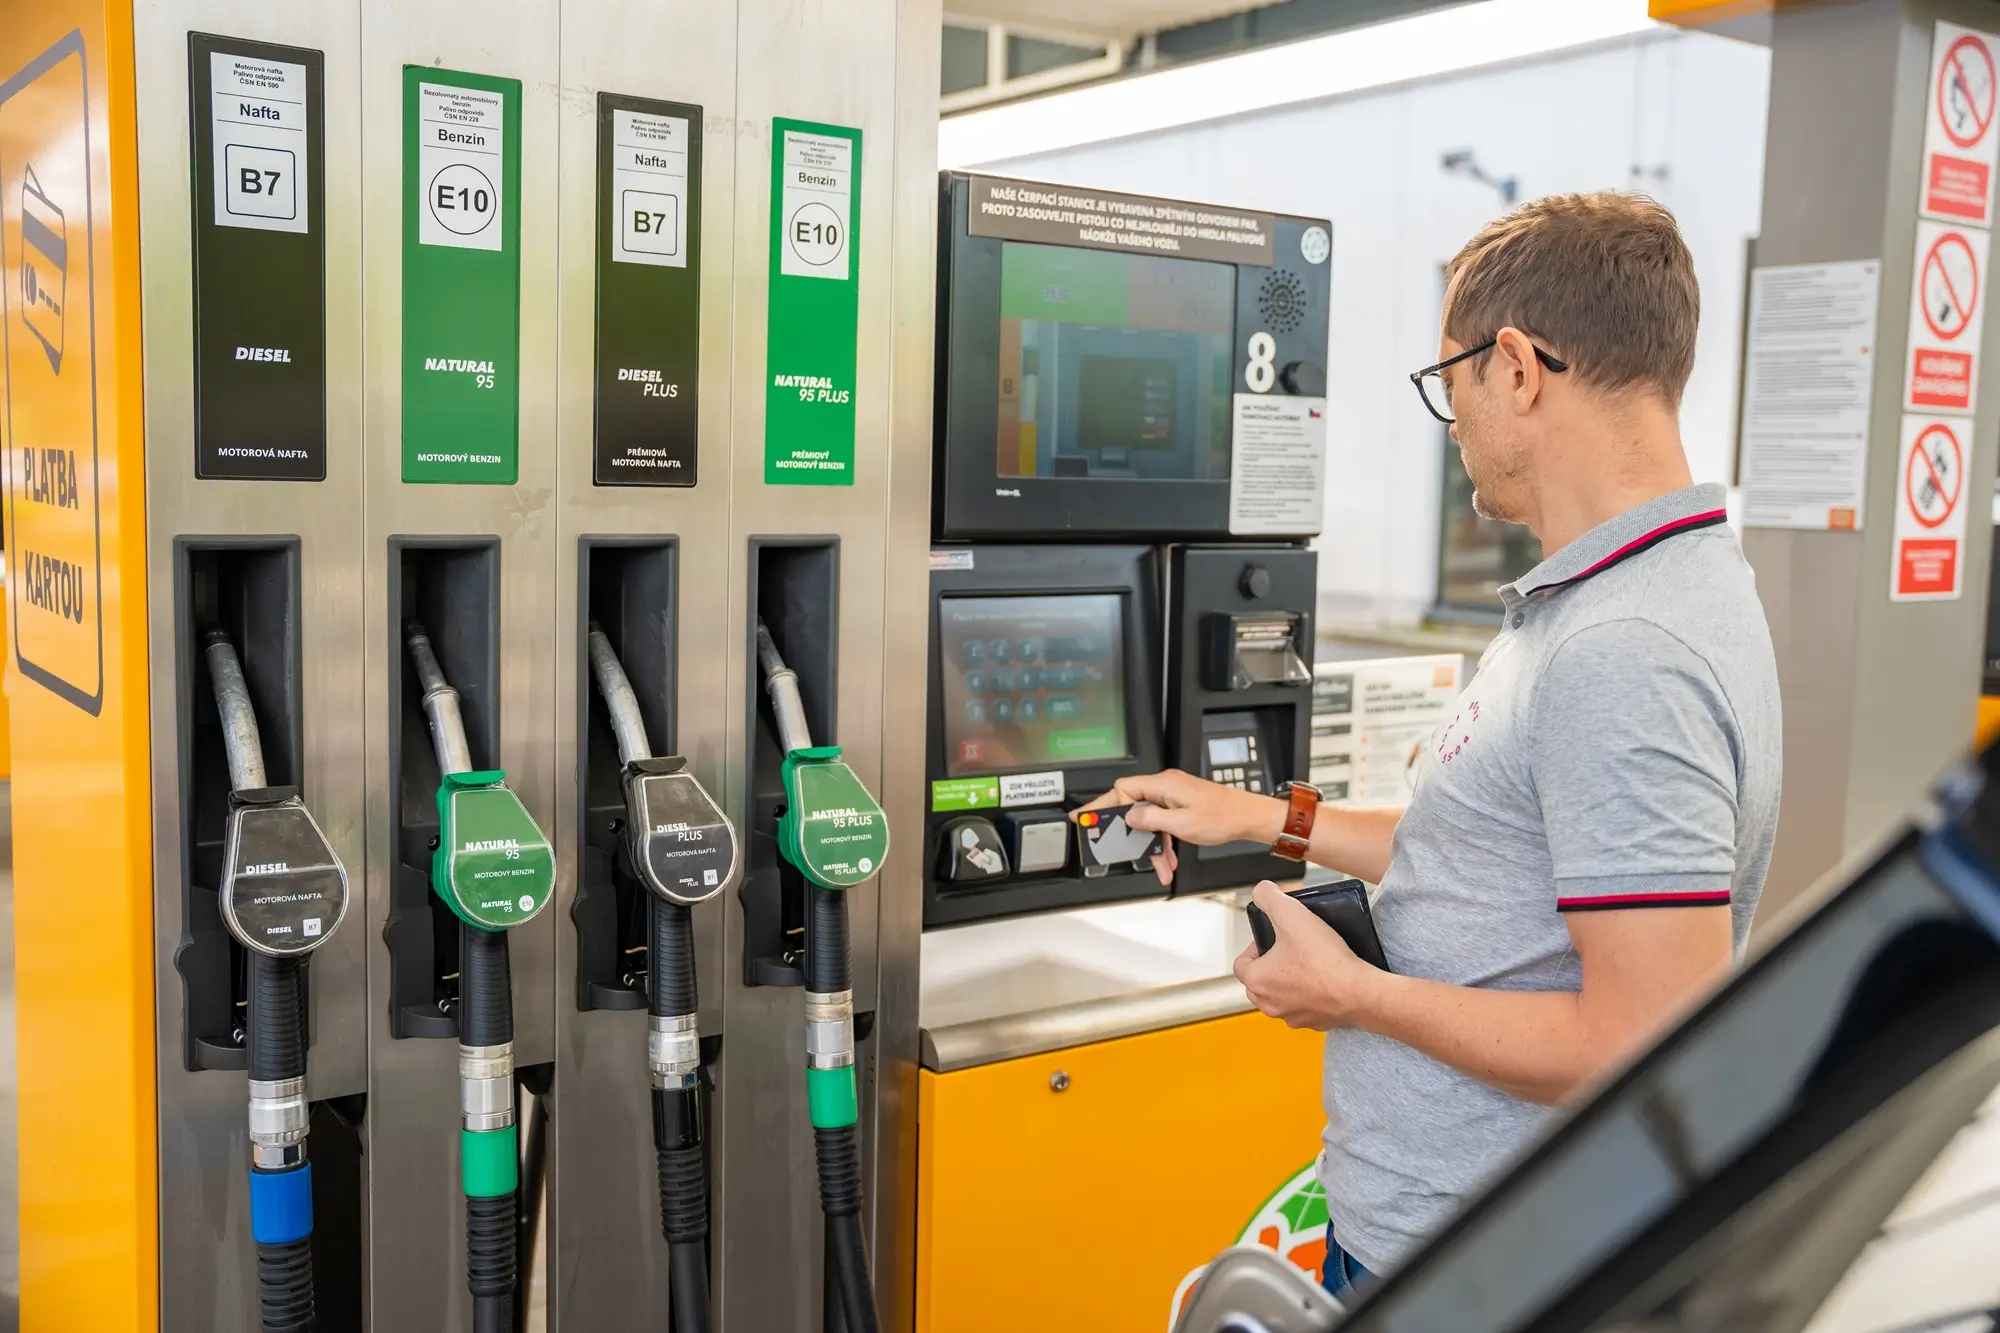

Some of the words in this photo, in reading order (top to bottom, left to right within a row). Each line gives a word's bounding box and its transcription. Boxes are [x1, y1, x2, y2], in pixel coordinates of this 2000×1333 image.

[235, 63, 265, 72] Motorová
[266, 66, 282, 74] nafta
[234, 70, 254, 78] Palivo
[254, 74, 284, 82] odpovídá
[240, 104, 280, 120] Nafta
[438, 128, 485, 146] Benzin
[636, 154, 667, 168] Nafta
[240, 168, 281, 196] B7
[798, 172, 836, 186] Benzin
[437, 185, 488, 212] E10
[991, 187, 1016, 201] NAŠE
[1018, 188, 1057, 205] ČERPACÍ
[1058, 196, 1095, 210] STANICE
[1096, 200, 1107, 211] JE
[634, 210, 666, 234] B7
[982, 202, 1015, 216] PROTO
[1016, 207, 1076, 224] ZASOUVEJTE
[1076, 213, 1109, 227] PISTOLI
[1111, 217, 1124, 229] CO
[1183, 226, 1197, 238] DO
[796, 222, 838, 245] E10
[235, 347, 291, 363] DIESEL
[425, 358, 495, 374] NATURAL
[1245, 332, 1276, 393] 8
[476, 375, 494, 389] 95
[618, 369, 662, 382] DIESEL
[775, 375, 832, 388] NATURAL
[644, 384, 678, 397] PLUS
[799, 389, 814, 401] 95
[818, 390, 849, 404] PLUS
[218, 447, 275, 458] MOTOROVÁ
[277, 449, 308, 459] NAFTA
[418, 452, 468, 463] MOTOROVÝ
[470, 454, 501, 464] BENZIN
[627, 447, 666, 457] PRÉMIOVÁ
[792, 450, 829, 459] PRÉMIOVÝ
[612, 458, 656, 467] MOTOROVÁ
[657, 459, 681, 468] NAFTA
[776, 459, 817, 469] MOTOROVÝ
[819, 462, 844, 470] BENZIN
[24, 447, 78, 510] PLATBA
[25, 550, 82, 624] KARTOU
[812, 808, 858, 819] NATURAL
[657, 823, 690, 833] DIESEL
[833, 818, 845, 828] 95
[848, 816, 872, 826] PLUS
[678, 831, 702, 842] PLUS
[821, 835, 851, 844] MOTOROVÝ
[465, 839, 519, 851] NATURAL
[505, 850, 520, 860] 95
[666, 849, 697, 858] MOTOROVÁ
[246, 862, 290, 875] DIESEL
[474, 870, 510, 879] MOTOROVÝ
[254, 893, 297, 904] MOTOROVÁ
[481, 900, 512, 908] NATURAL
[267, 926, 292, 935] DIESEL
